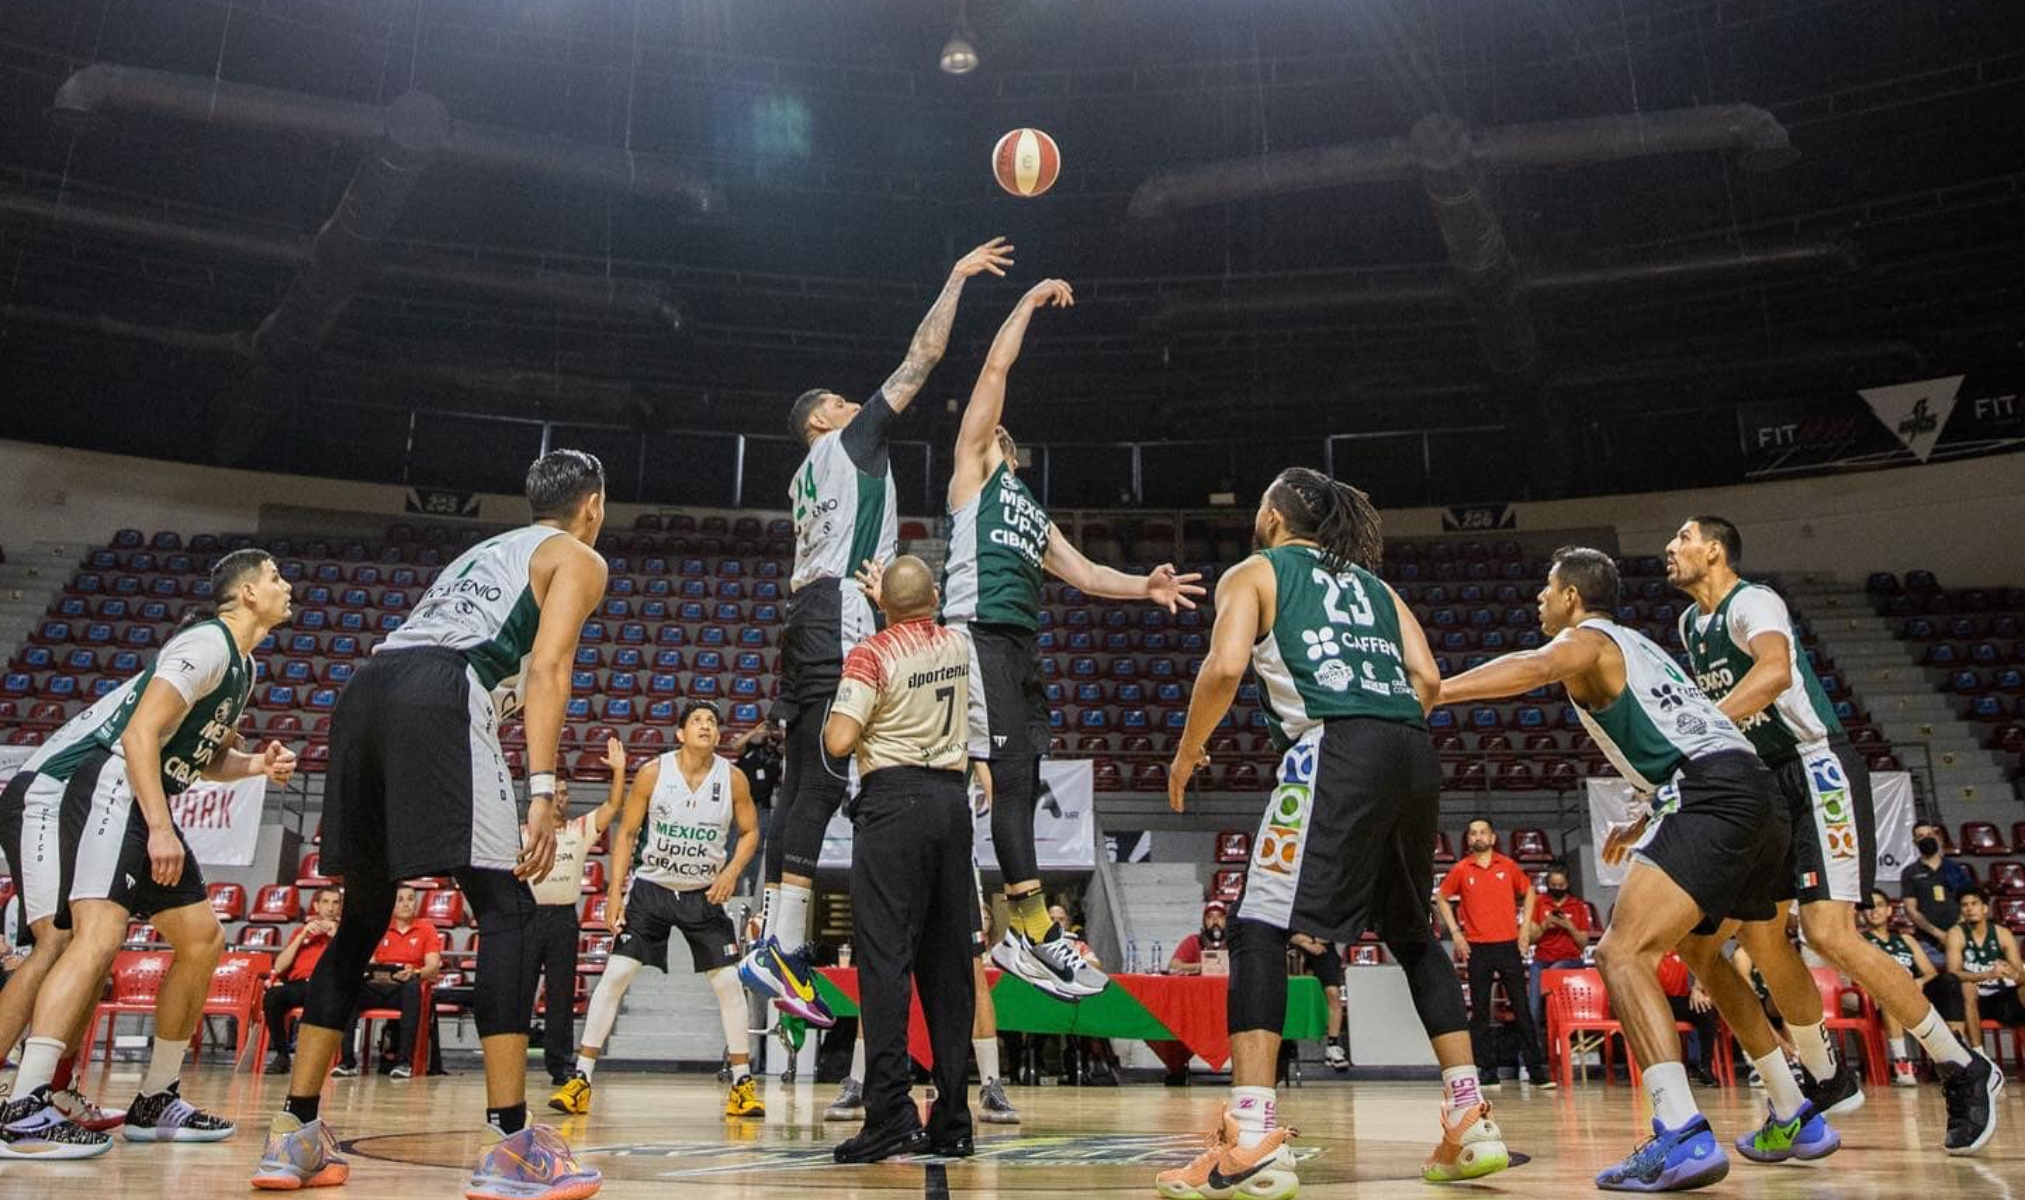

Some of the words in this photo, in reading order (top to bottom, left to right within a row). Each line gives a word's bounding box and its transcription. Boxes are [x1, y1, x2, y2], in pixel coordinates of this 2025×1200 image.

[1312, 567, 1375, 627] 23
[935, 686, 955, 737] 7
[656, 820, 717, 842] MÉXICO
[657, 837, 708, 858] Upick
